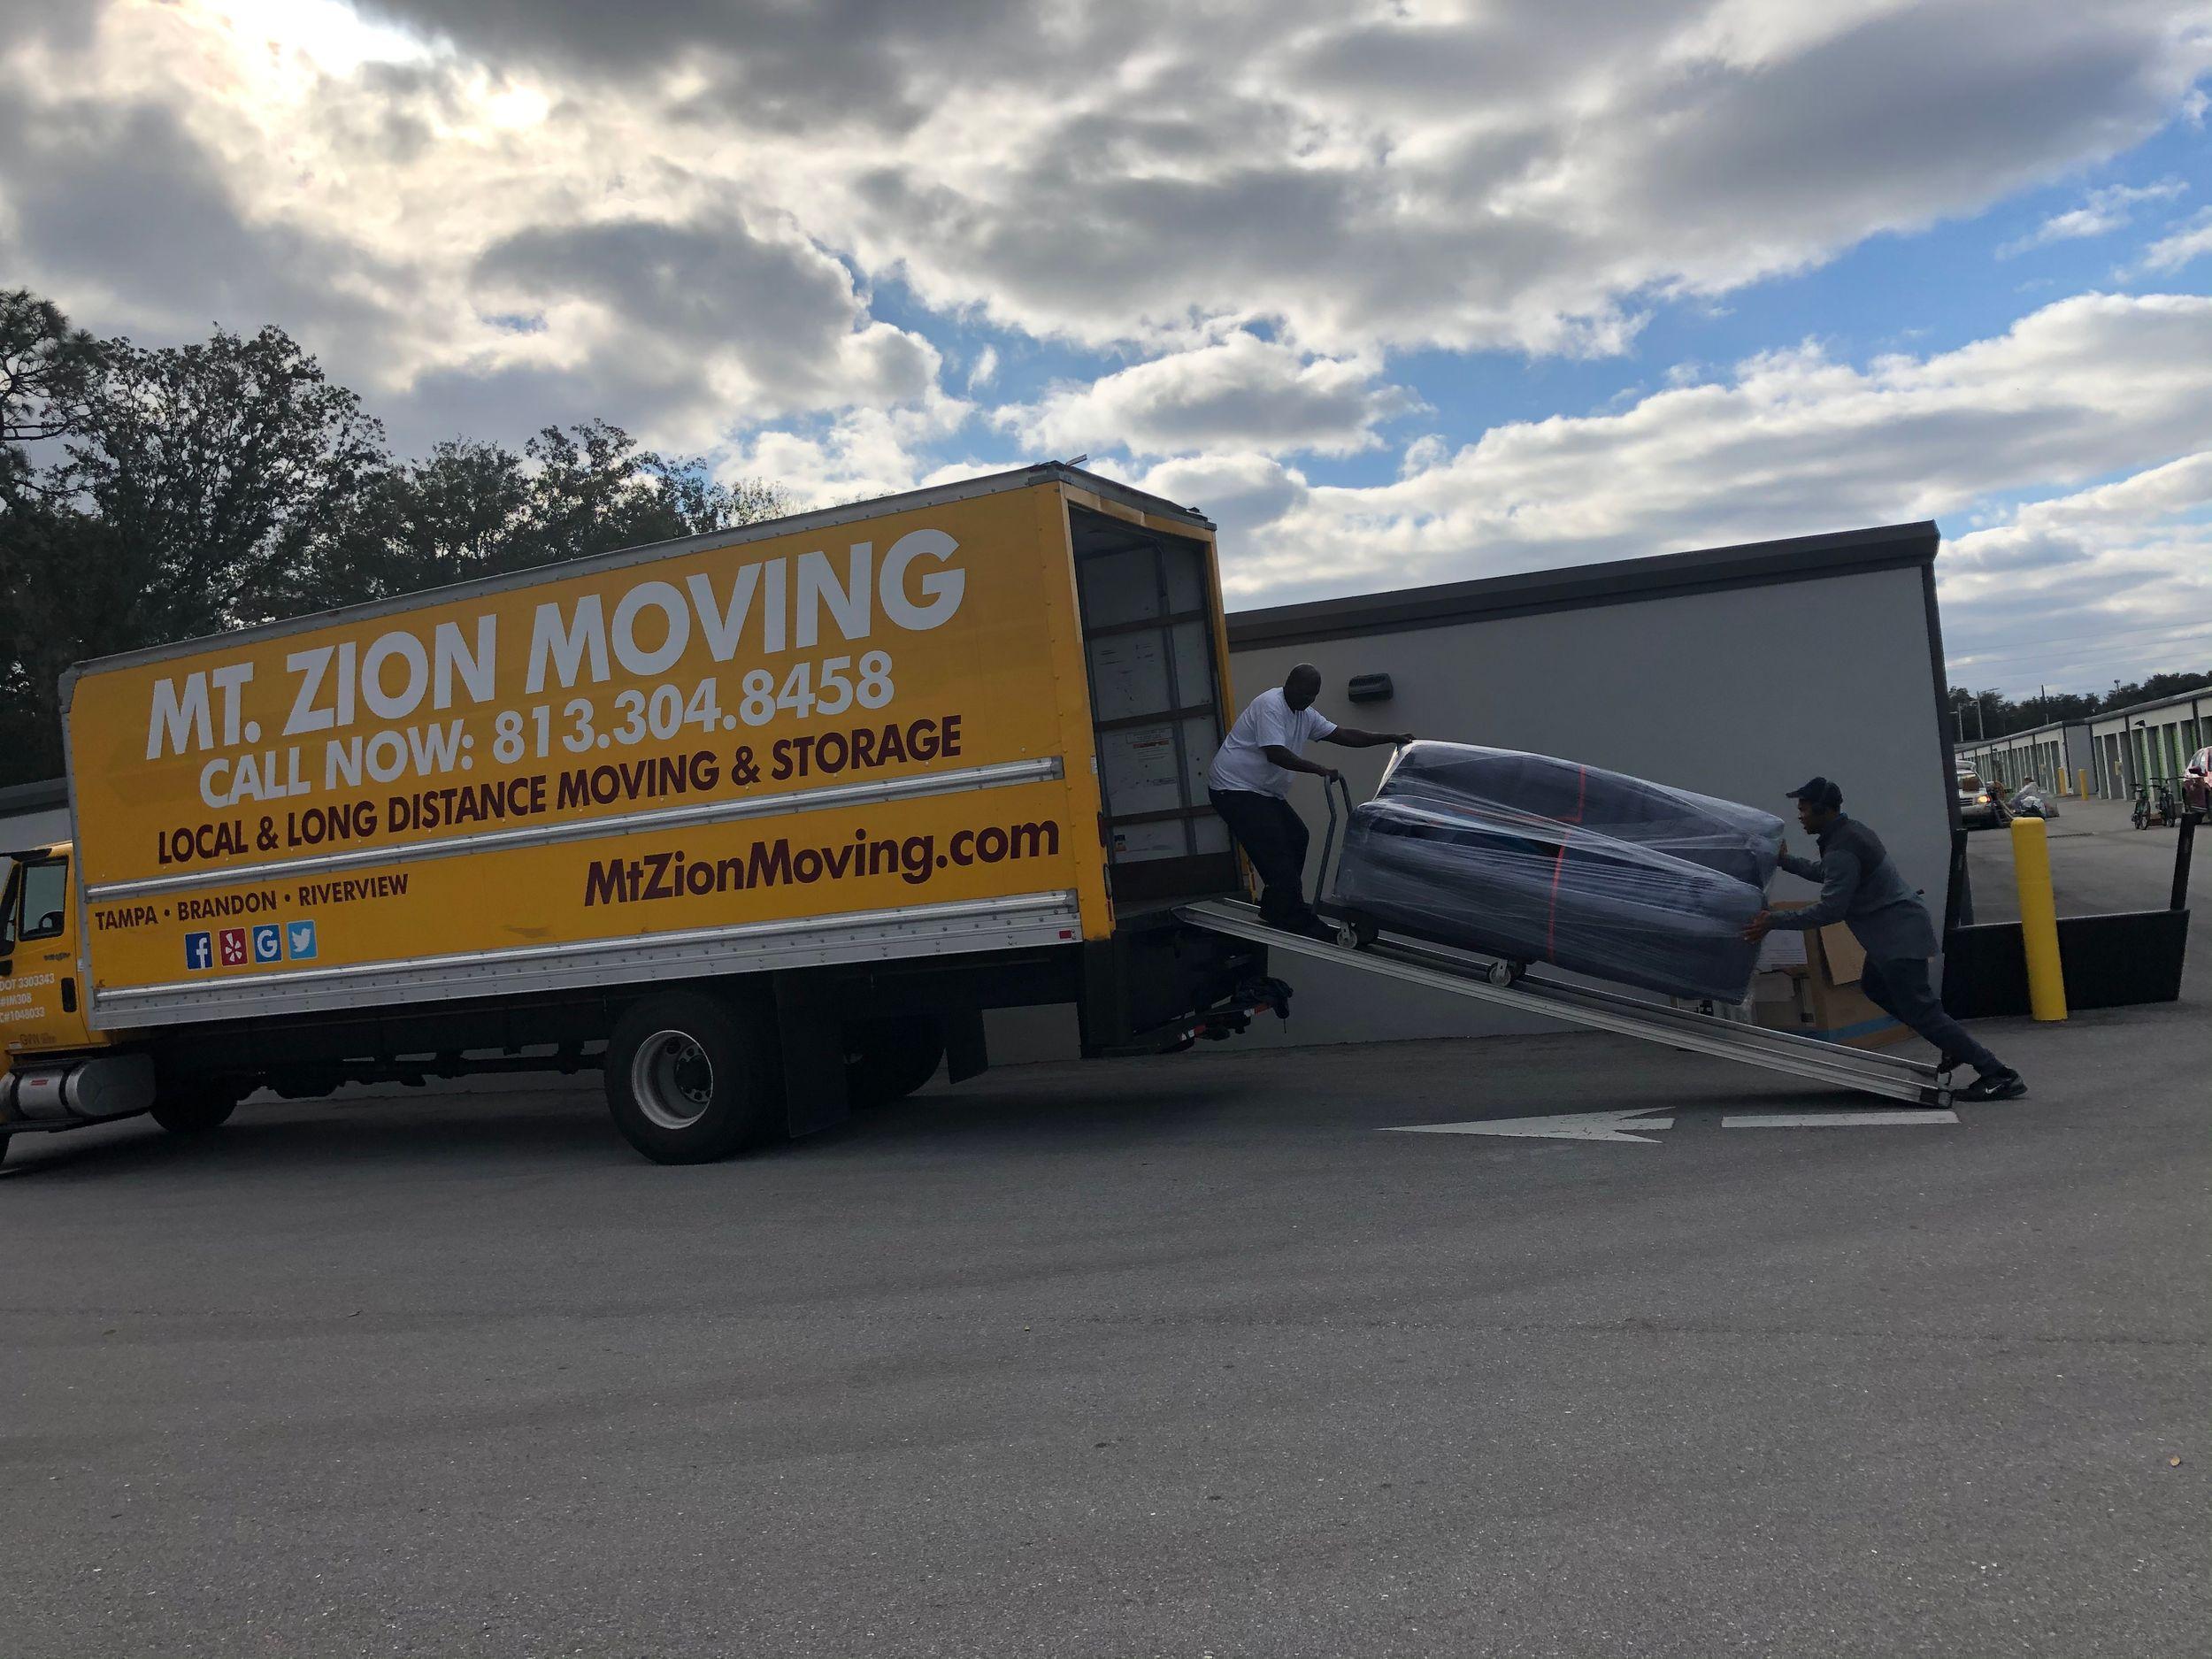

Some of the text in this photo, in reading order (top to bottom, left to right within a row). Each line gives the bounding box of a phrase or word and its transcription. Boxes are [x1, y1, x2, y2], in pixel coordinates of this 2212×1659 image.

[147, 528, 965, 760] MT. ZION MOVING
[158, 715, 962, 864] LOCAL & LONG DISTANCE MOVING & STORAGE
[200, 649, 895, 809] CALL NOW: 813.304.8458
[95, 873, 410, 931] TAMPA BRANDON RIVERVIEW
[584, 819, 1060, 907] MtZionMoving.com
